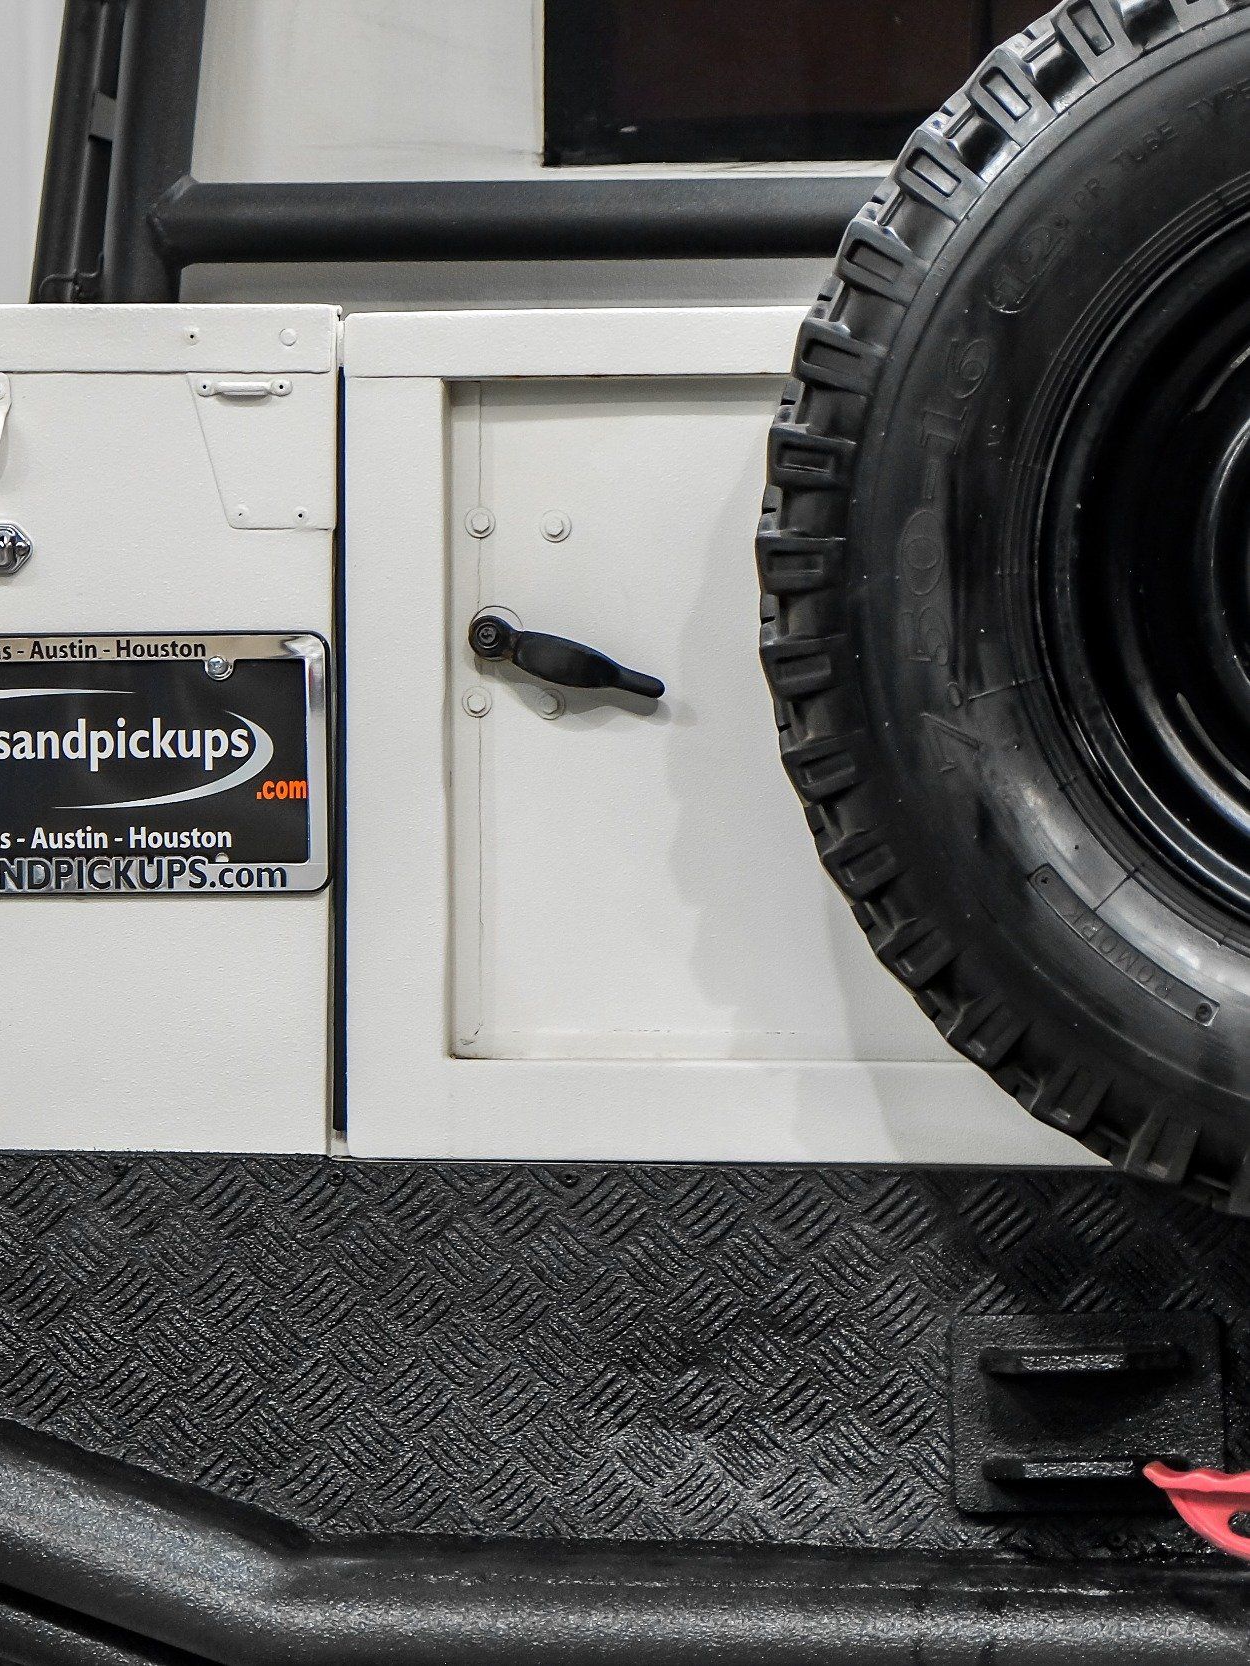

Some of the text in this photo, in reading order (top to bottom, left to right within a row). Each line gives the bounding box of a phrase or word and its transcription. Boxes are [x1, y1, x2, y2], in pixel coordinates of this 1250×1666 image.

[30, 639, 98, 660] Austin
[115, 639, 207, 659] Houston
[256, 780, 307, 800] .com
[30, 826, 108, 849] Austin
[129, 826, 233, 848] Houston
